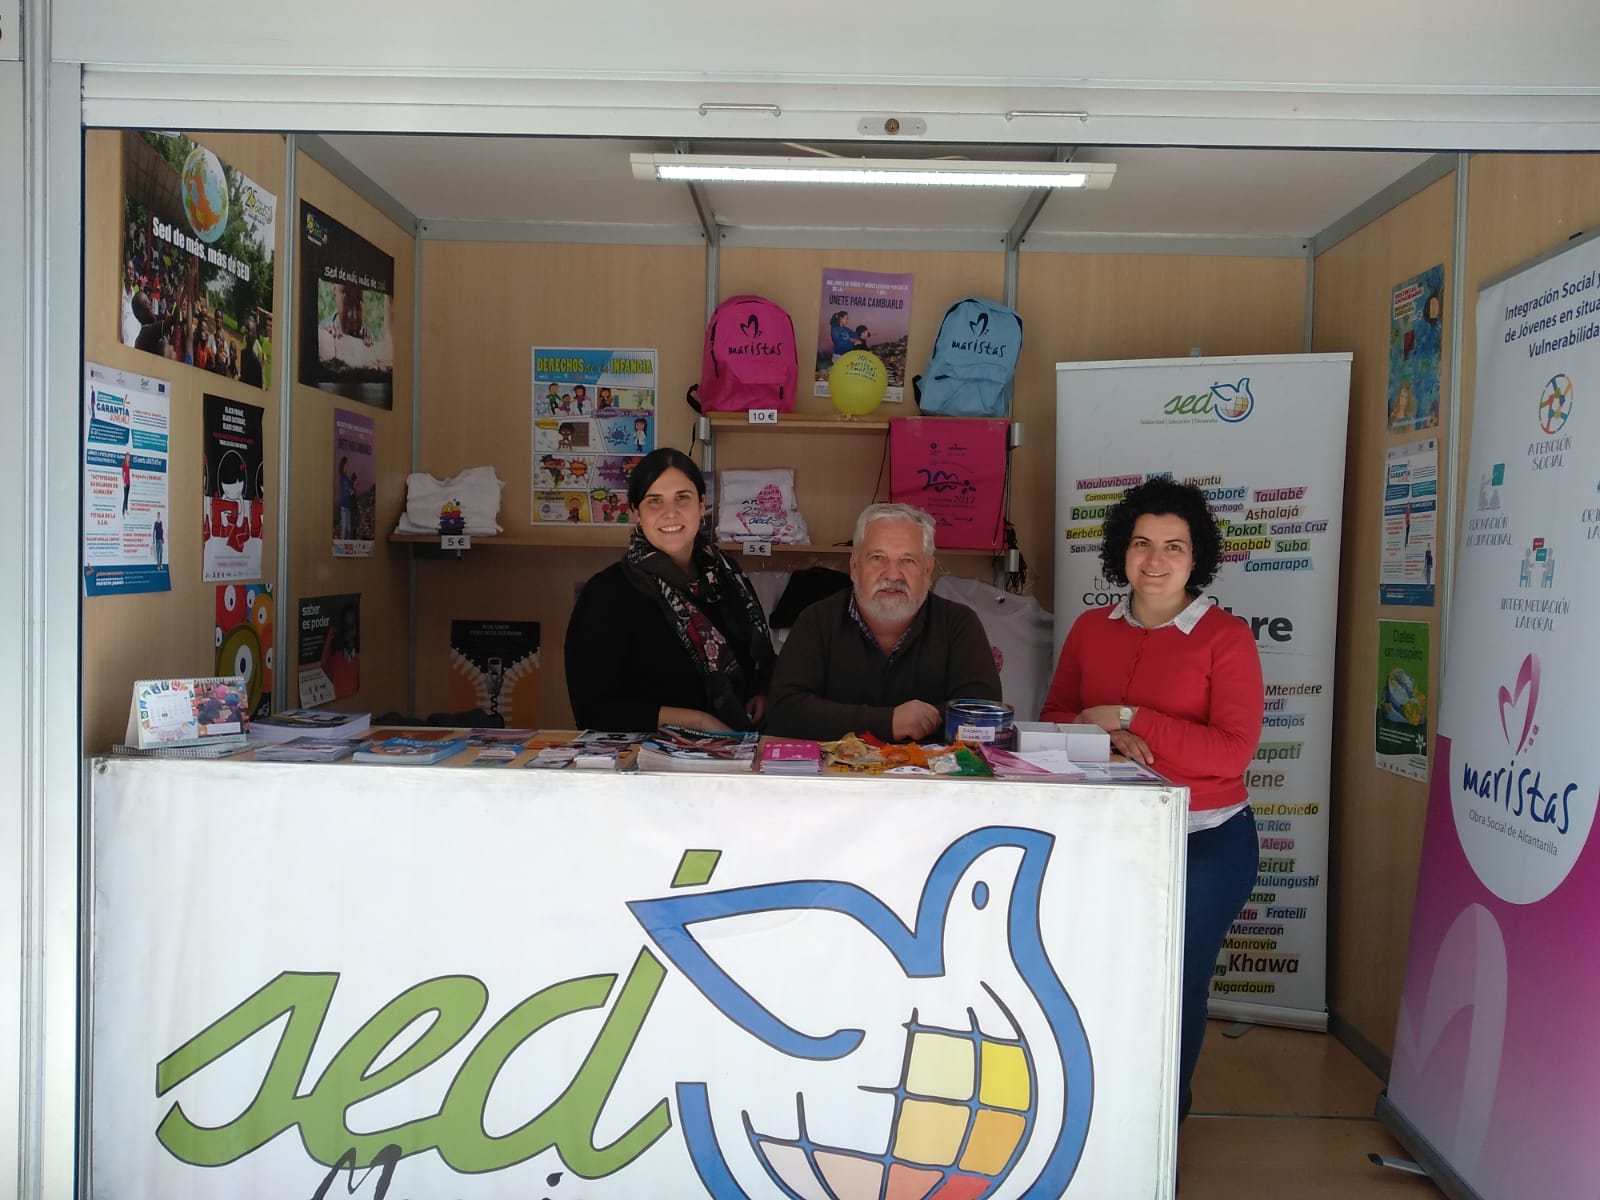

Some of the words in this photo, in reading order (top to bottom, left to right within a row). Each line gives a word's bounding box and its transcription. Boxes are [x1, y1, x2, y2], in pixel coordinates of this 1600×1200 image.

[153, 217, 171, 243] Sed
[173, 228, 185, 249] de
[186, 236, 206, 261] más,
[208, 247, 227, 269] más
[228, 255, 236, 274] de
[236, 260, 250, 282] SED
[850, 296, 866, 307] PARA
[868, 297, 903, 310] CAMBIARLO
[1505, 288, 1559, 321] Integración
[1561, 270, 1596, 298] Social
[1505, 328, 1516, 343] de
[1517, 314, 1557, 339] Jóvenes
[1560, 309, 1573, 323] en
[1576, 298, 1600, 318] situa
[1529, 322, 1600, 358] Vulnerabilida
[728, 342, 782, 356] maristas
[952, 340, 1006, 357] maristas
[537, 357, 584, 373] DERECHOS
[612, 358, 653, 374] INFANCIA
[1164, 382, 1217, 415] sed
[753, 412, 765, 421] 10
[768, 412, 775, 420] €
[1528, 433, 1573, 456] ATENCIÓN
[1532, 454, 1565, 471] SOCIAL
[1184, 475, 1221, 487] Ubuntu
[1255, 487, 1304, 502] Taulabé
[1072, 504, 1112, 521] Bouak
[1246, 504, 1299, 521] Ashalajá
[1066, 526, 1103, 540] Berbéra
[1226, 523, 1262, 537] Pokot
[1270, 525, 1302, 536] Santa
[1304, 521, 1328, 533] Cruz
[1587, 525, 1600, 540] LA
[448, 538, 455, 546] 5
[458, 538, 465, 546] €
[749, 545, 756, 553] 5
[759, 545, 766, 553] €
[1070, 545, 1086, 554] San
[1224, 538, 1271, 552] Baobab
[1276, 540, 1308, 553] Suba
[1245, 559, 1308, 573] Comarapa
[302, 603, 320, 616] saber
[1500, 597, 1570, 616] INTERMEDIACIÓN
[302, 621, 311, 630] es
[311, 616, 330, 631] poder
[1515, 615, 1555, 632] LABORAL
[1265, 683, 1322, 696] Mtendere
[1262, 716, 1305, 729] Patojos
[1256, 744, 1302, 763] apati
[1245, 769, 1285, 788] lene
[1463, 760, 1578, 834] maristas
[1252, 804, 1275, 816] onel
[1277, 803, 1319, 816] Oviedo
[1268, 820, 1291, 832] Rica
[1469, 808, 1486, 825] Obra
[1487, 816, 1506, 834] Social
[1507, 825, 1517, 838] de
[1518, 829, 1558, 856] Alcantarilla
[1261, 838, 1295, 852] Alepo
[1258, 858, 1295, 873] eirut
[1248, 892, 1276, 903] anza
[1266, 907, 1307, 919] Fratelli
[1230, 924, 1284, 936] Merceron
[1222, 938, 1277, 950] Monrovia
[1216, 964, 1227, 976] rg
[1229, 953, 1299, 973] Khawa
[1214, 981, 1275, 995] Ngardoum
[157, 849, 721, 1180] sed
